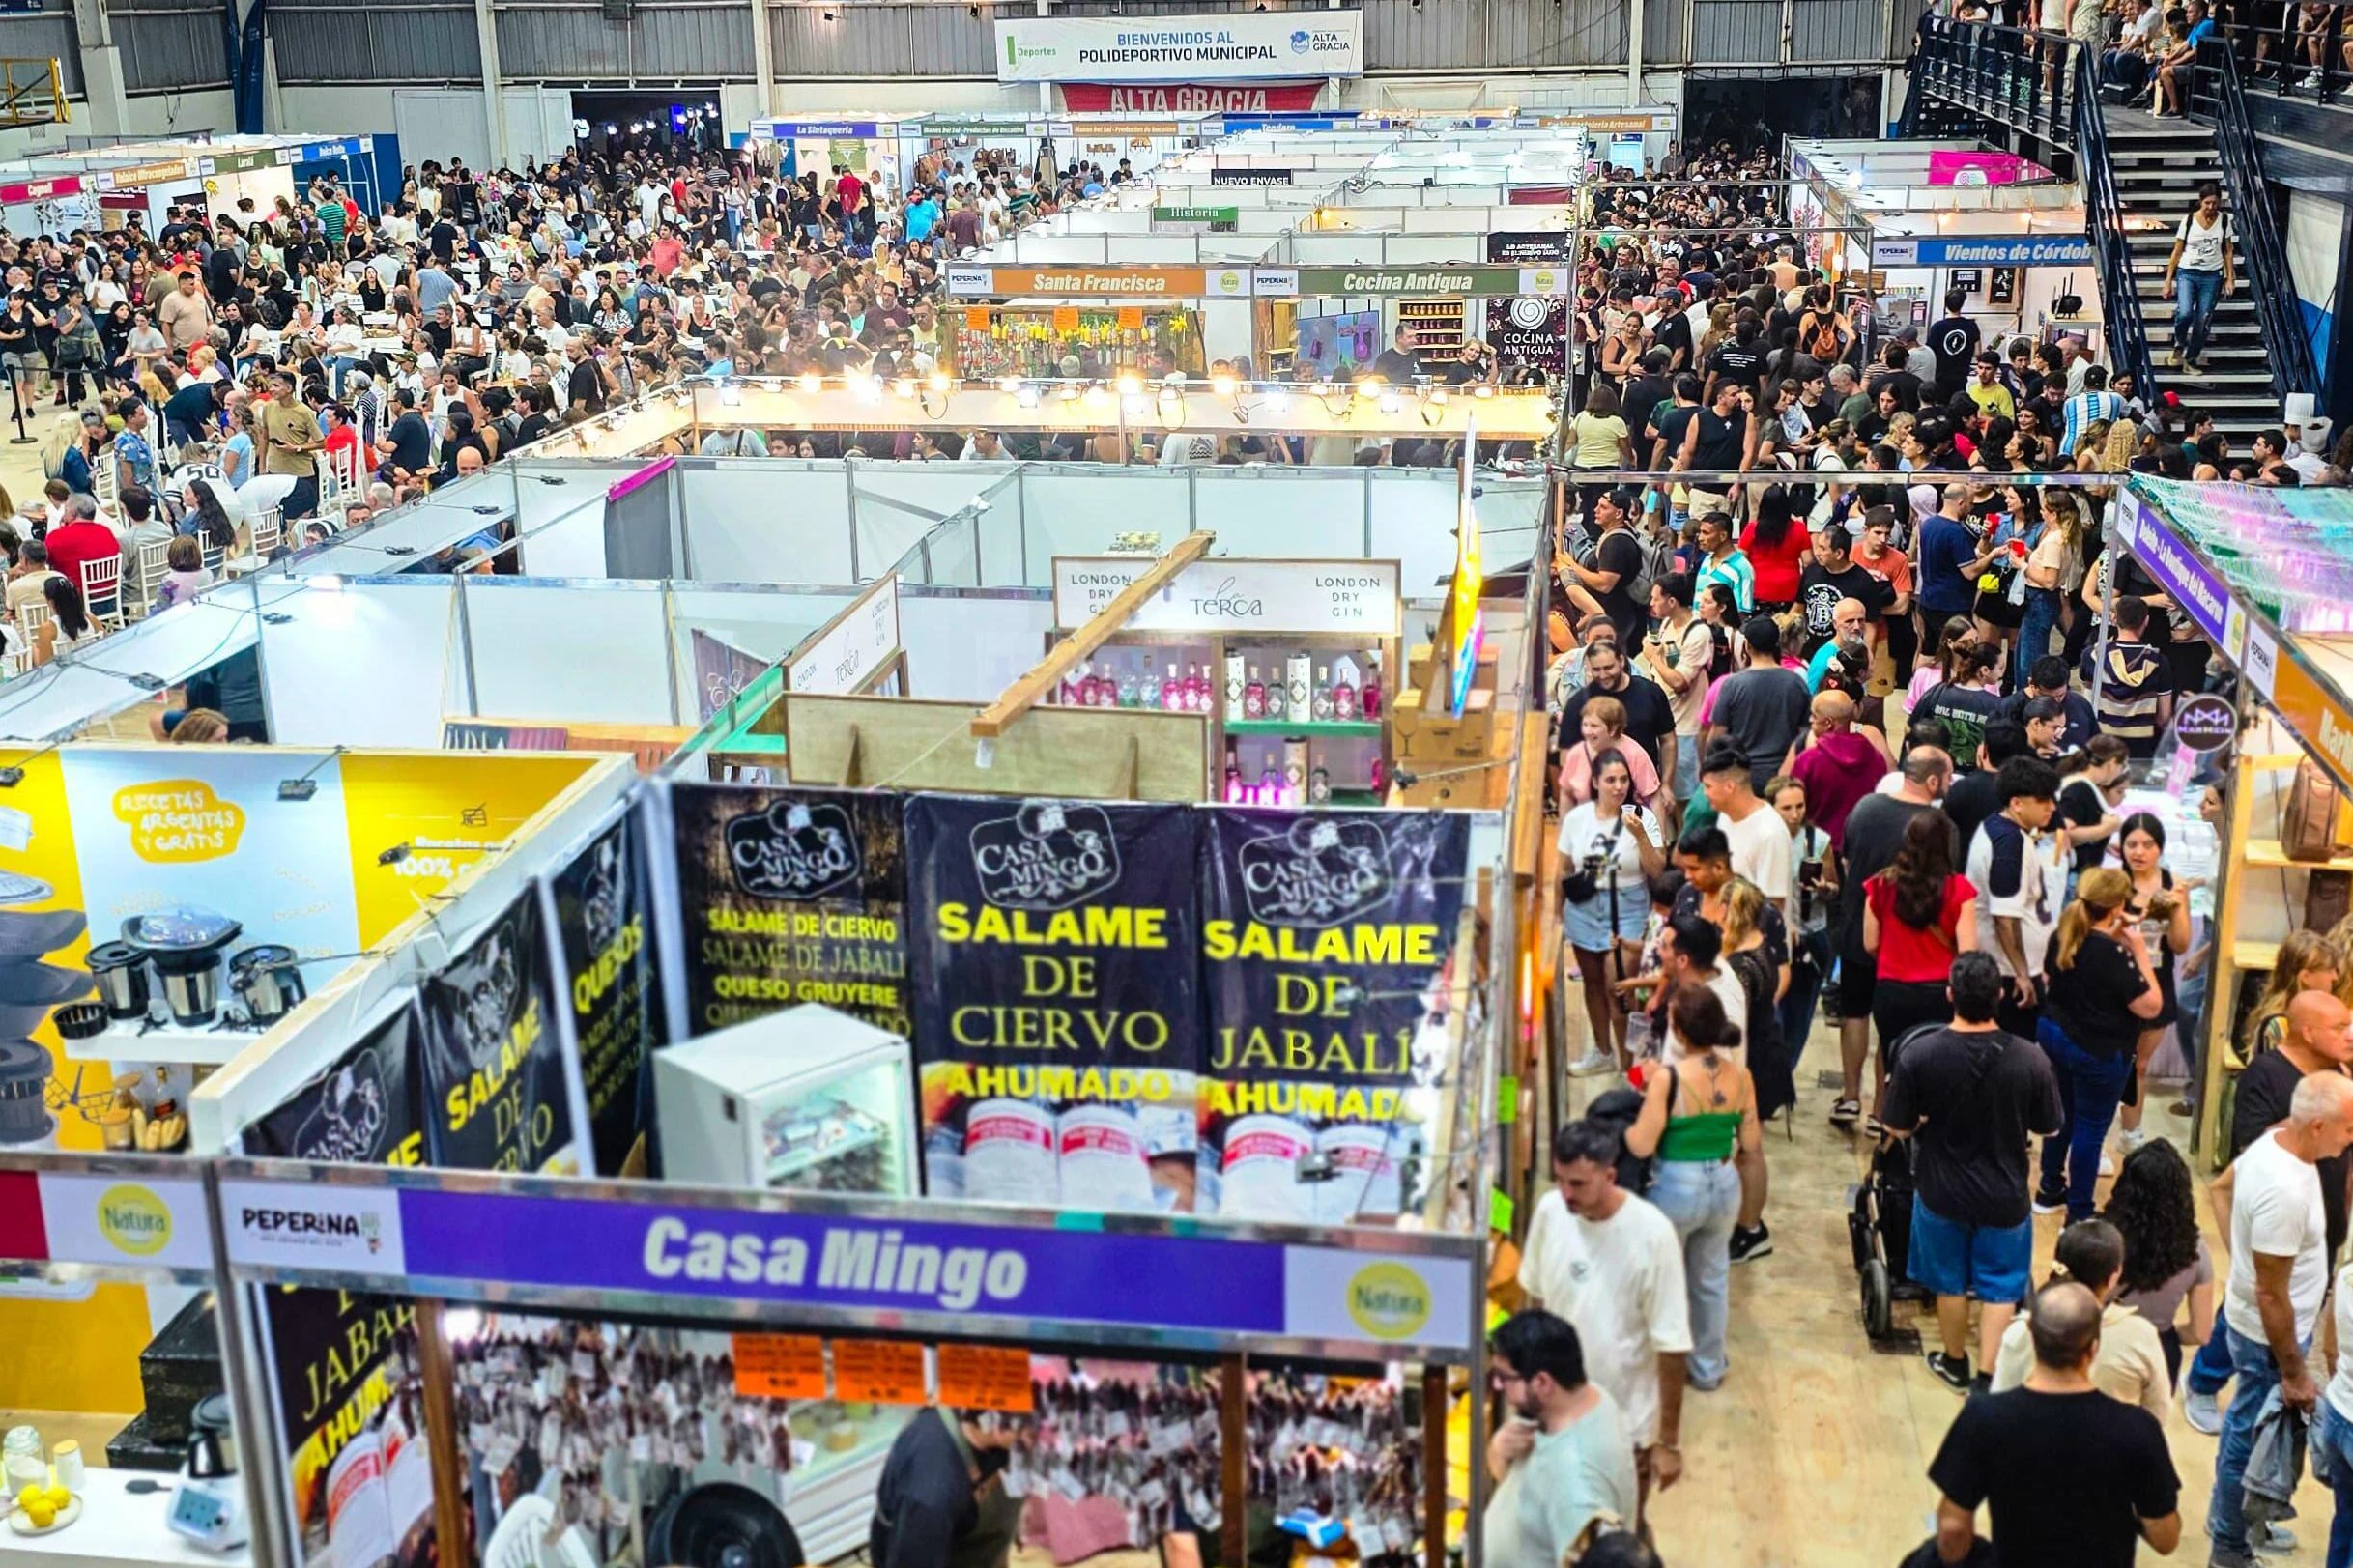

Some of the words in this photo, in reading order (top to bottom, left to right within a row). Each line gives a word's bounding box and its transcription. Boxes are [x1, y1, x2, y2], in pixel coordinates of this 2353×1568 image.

[1018, 45, 1057, 58] Deportes
[1117, 32, 1212, 46] BIENVENIDOS
[1217, 31, 1235, 43] AL
[1312, 33, 1337, 43] ALTA
[1312, 42, 1350, 51] GRACIA
[1078, 47, 1192, 63] POLIDEPORTIVO
[1195, 45, 1277, 61] MUNICIPAL
[1110, 88, 1169, 111] ALTA
[1176, 88, 1267, 111] GRACIA
[1214, 177, 1248, 185] NUEVO
[1250, 177, 1289, 185] ENVASE
[1945, 244, 2008, 262] Vientos
[2010, 244, 2030, 261] de
[2033, 242, 2093, 260] Córdob
[1033, 274, 1081, 291] Santa
[1083, 274, 1165, 292] Francisca
[1344, 273, 1402, 291] Cocina
[1404, 273, 1472, 294] Antigua
[1503, 345, 1554, 356] ANTIGUA
[1071, 574, 1132, 586] LONDON
[1089, 589, 1115, 600] DRY
[1315, 577, 1381, 588] LONDON
[1332, 591, 1360, 603] DRY
[1332, 607, 1363, 617] GIN
[120, 791, 206, 812] RECETAS
[140, 810, 236, 832] ARGENTAS
[139, 835, 152, 851] Y
[733, 836, 802, 868] CASA
[977, 839, 1055, 875] CASA
[394, 857, 453, 878] 100%
[761, 842, 849, 877] MINGO
[1008, 850, 1109, 887] MINGO
[1246, 855, 1328, 893] CASA
[1277, 865, 1378, 903] MINGO
[707, 908, 788, 934] SALAME
[794, 912, 820, 937] DE
[826, 914, 898, 944] CIERVO
[936, 901, 1168, 948] SALAME
[702, 937, 789, 970] SALAME
[795, 942, 823, 972] DE
[1203, 920, 1439, 965] SALAME
[1021, 955, 1098, 998] DE
[714, 975, 790, 1000] QUESO
[797, 980, 899, 1009] GRUYERE
[1274, 973, 1353, 1018] DE
[950, 1005, 1170, 1053] CIERVO
[445, 996, 542, 1132] SALAME
[1210, 1025, 1413, 1076] JABALÍ
[946, 1064, 1172, 1101] AHUMADO
[1209, 1080, 1403, 1121] AHUMAD
[104, 1206, 166, 1232] Natura
[643, 1216, 810, 1286] Casa
[817, 1228, 1028, 1312] Mingo
[1356, 1284, 1425, 1316] Natura
[302, 1304, 419, 1422] JABA
